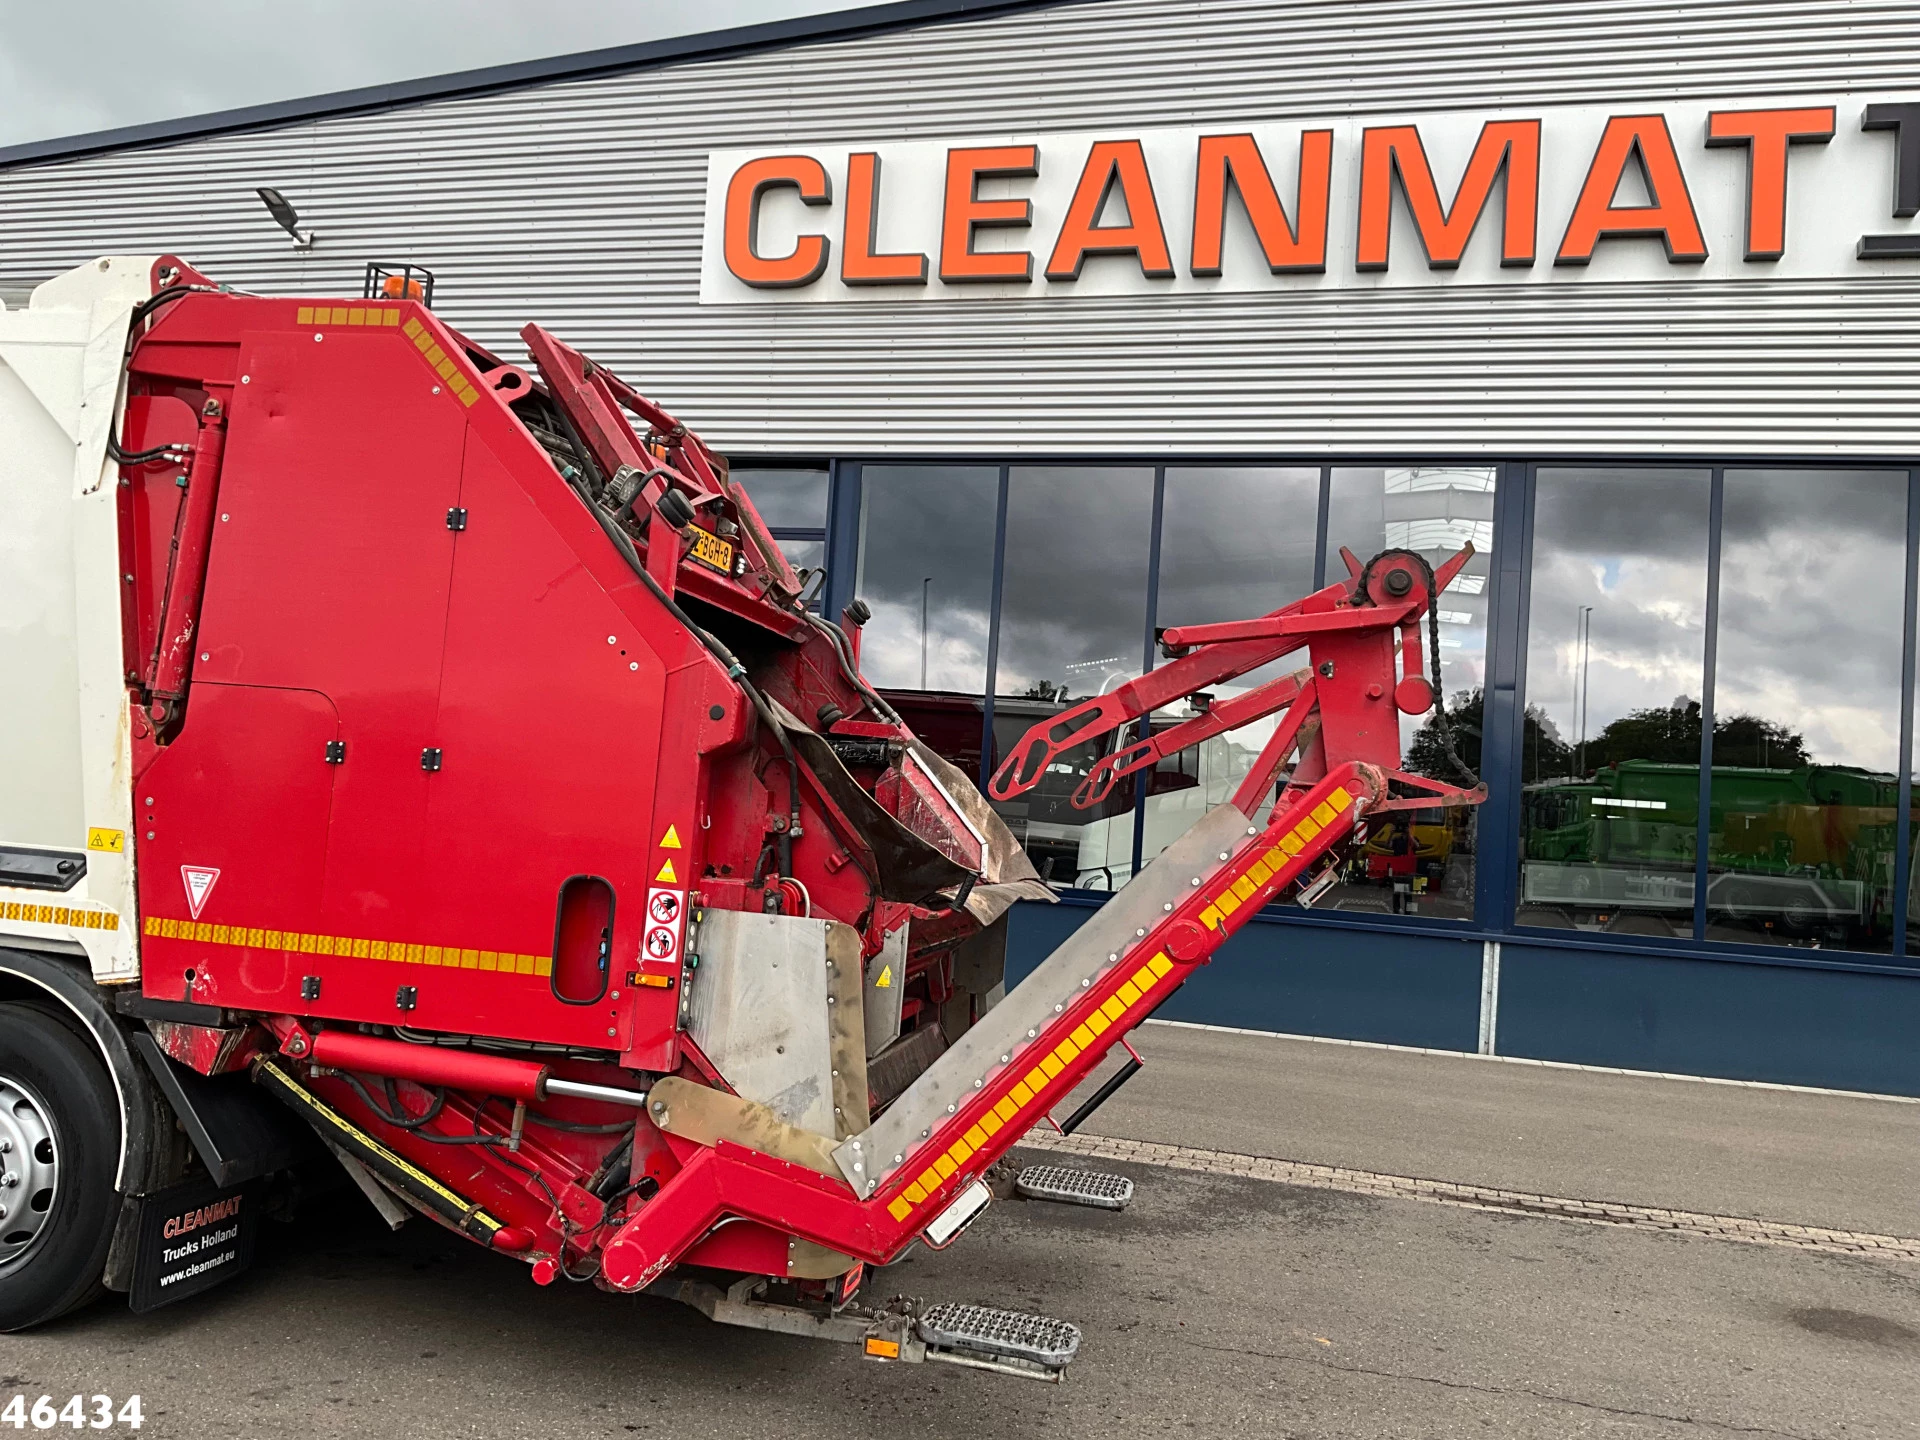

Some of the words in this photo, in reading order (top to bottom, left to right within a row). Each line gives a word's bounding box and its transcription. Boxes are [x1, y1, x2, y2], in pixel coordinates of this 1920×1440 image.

[722, 106, 1836, 290] CLEANMAT
[163, 1194, 242, 1239] CLEANMAT
[163, 1241, 199, 1263] Trucks
[201, 1224, 238, 1250] Holland
[160, 1250, 235, 1287] www.cleanmat.eu
